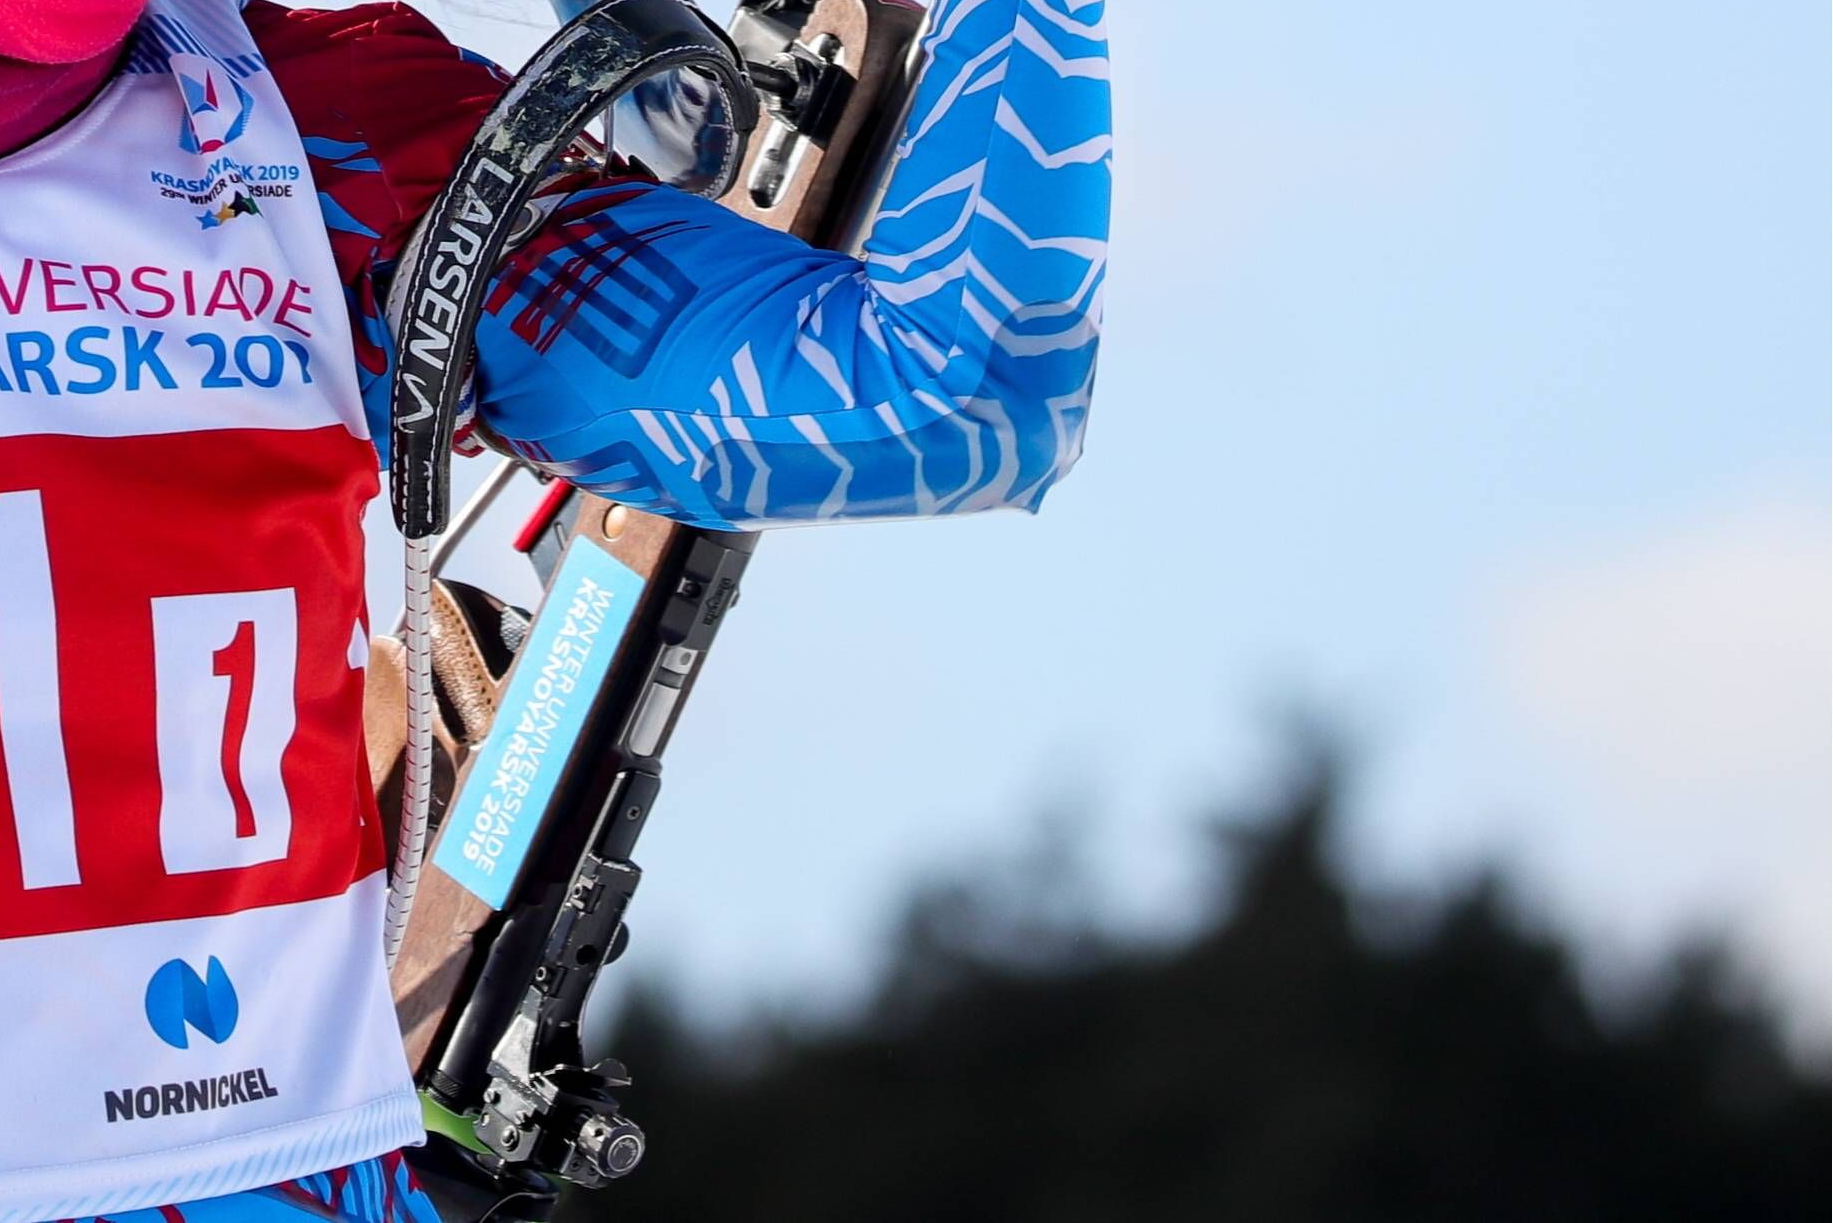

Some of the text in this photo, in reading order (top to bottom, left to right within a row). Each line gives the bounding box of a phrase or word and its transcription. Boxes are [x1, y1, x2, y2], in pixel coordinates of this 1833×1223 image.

[151, 157, 300, 192] KRASNOYAK 2019
[188, 178, 227, 205] WINTER
[409, 156, 514, 371] LARSEN
[212, 620, 257, 838] 1
[462, 576, 597, 863] KRASNOYARSK 2019
[477, 588, 615, 876] WINTER UNIVERSIADE
[104, 1067, 279, 1122] NORNICKEL
